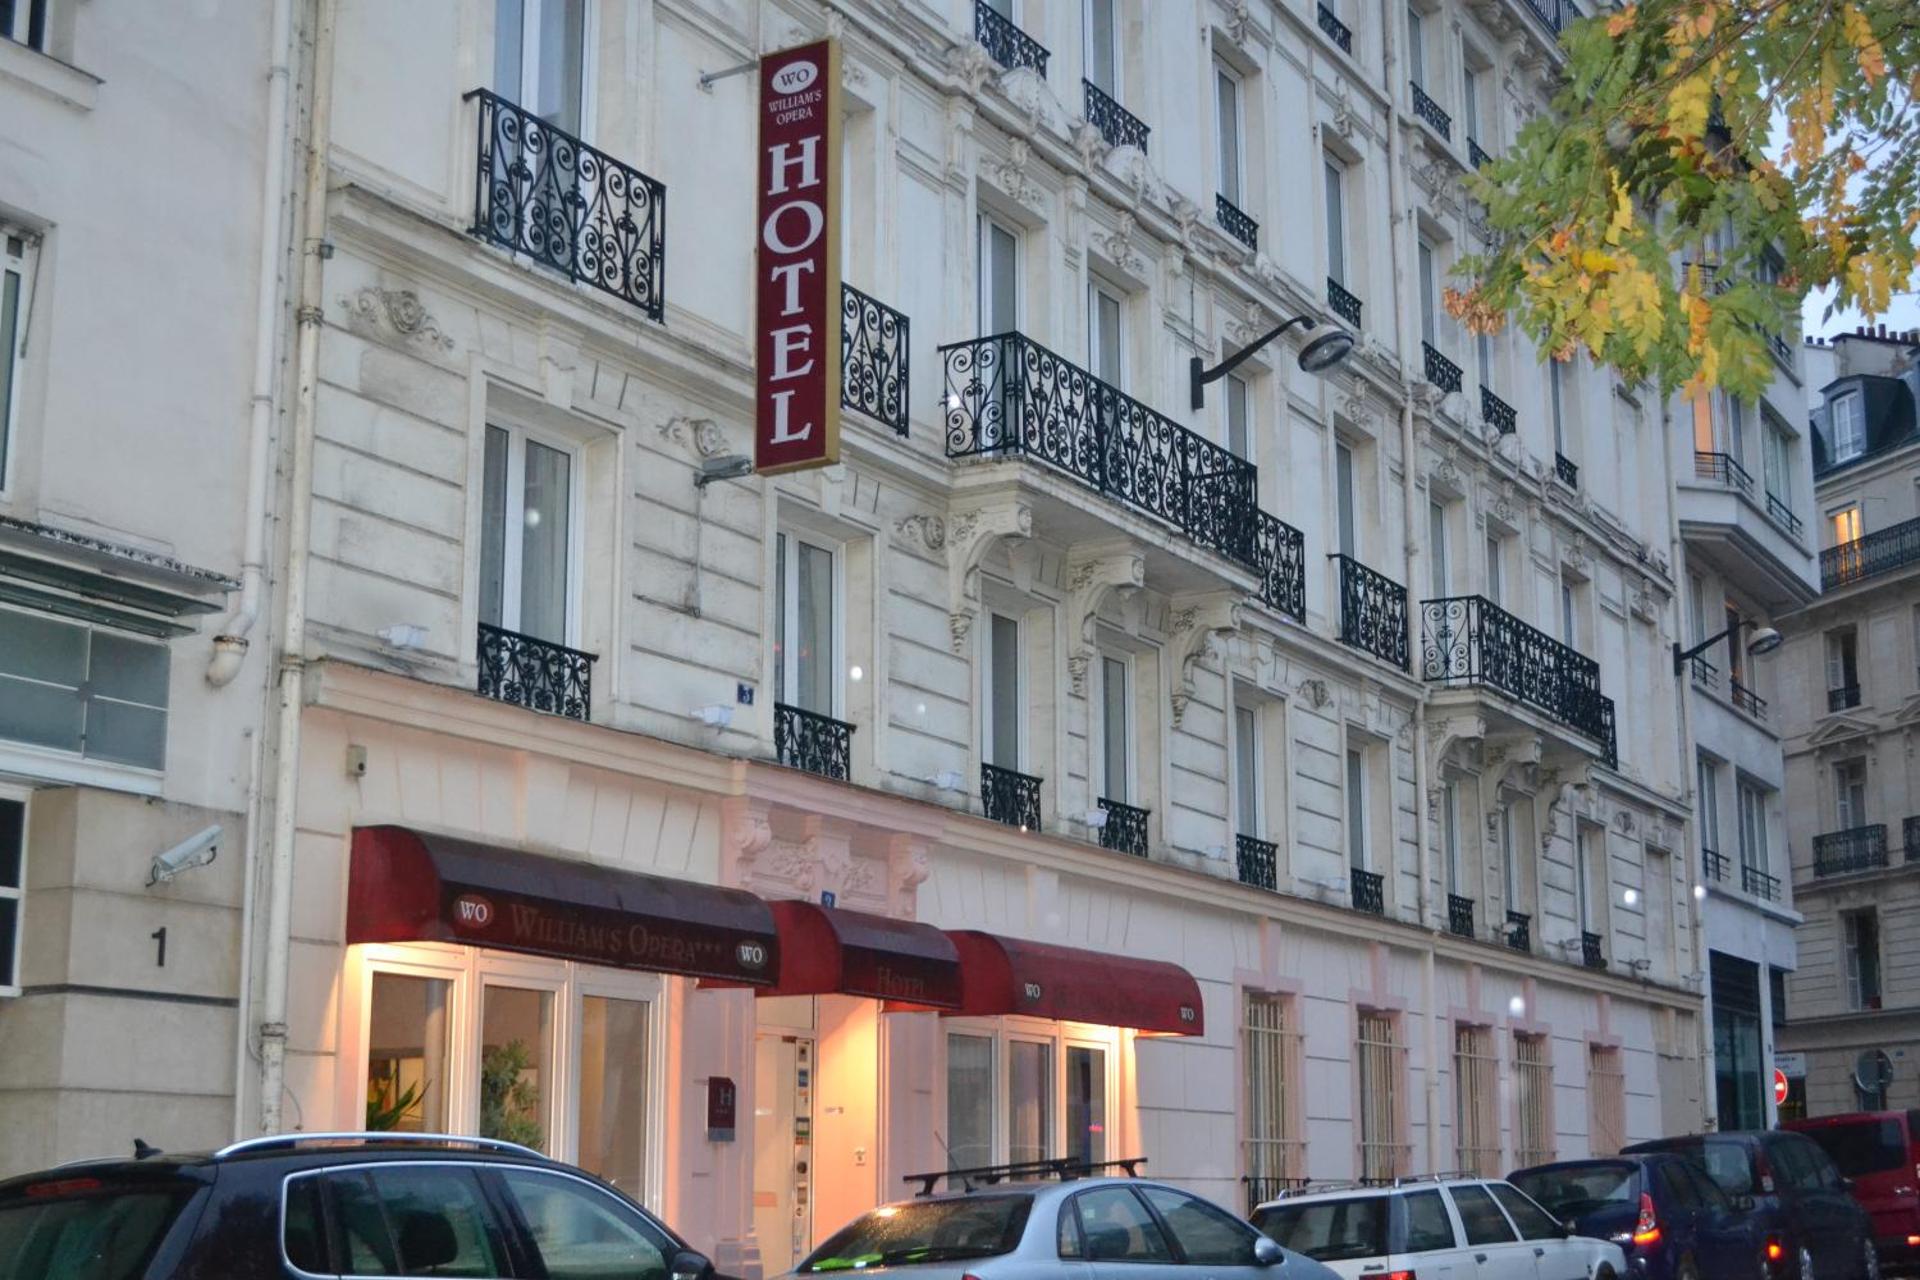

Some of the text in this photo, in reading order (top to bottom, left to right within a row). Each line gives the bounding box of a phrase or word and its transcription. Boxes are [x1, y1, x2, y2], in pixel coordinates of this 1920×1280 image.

[780, 69, 809, 86] WO
[768, 89, 822, 113] WILLIAM'S
[776, 106, 813, 125] OPERA
[762, 134, 824, 445] HOTEL
[460, 900, 488, 922] WO
[151, 926, 167, 967] 1
[738, 945, 763, 964] WO
[1024, 982, 1041, 999] WO
[1180, 1006, 1195, 1021] WO
